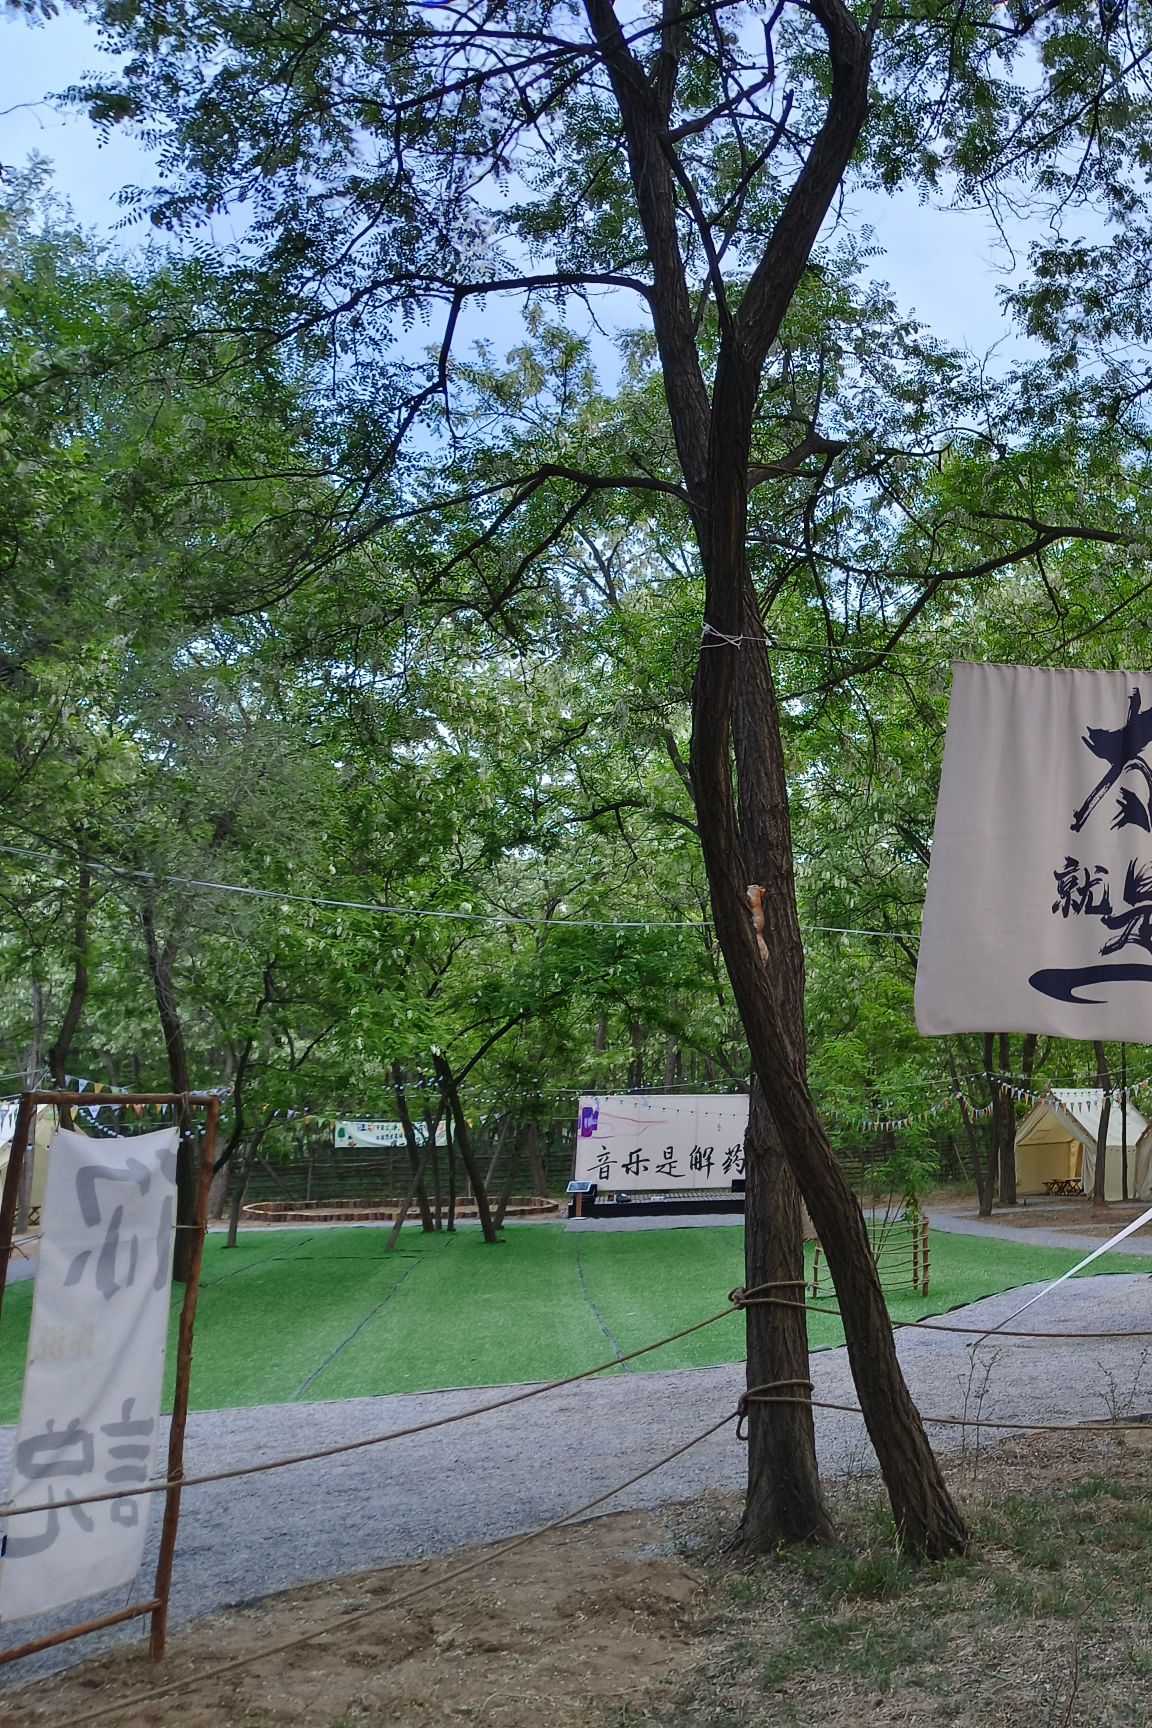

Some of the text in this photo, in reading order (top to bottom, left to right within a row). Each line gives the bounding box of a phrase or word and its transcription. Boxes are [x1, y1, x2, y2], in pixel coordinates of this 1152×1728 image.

[587, 1144, 745, 1180] 音乐是解药
